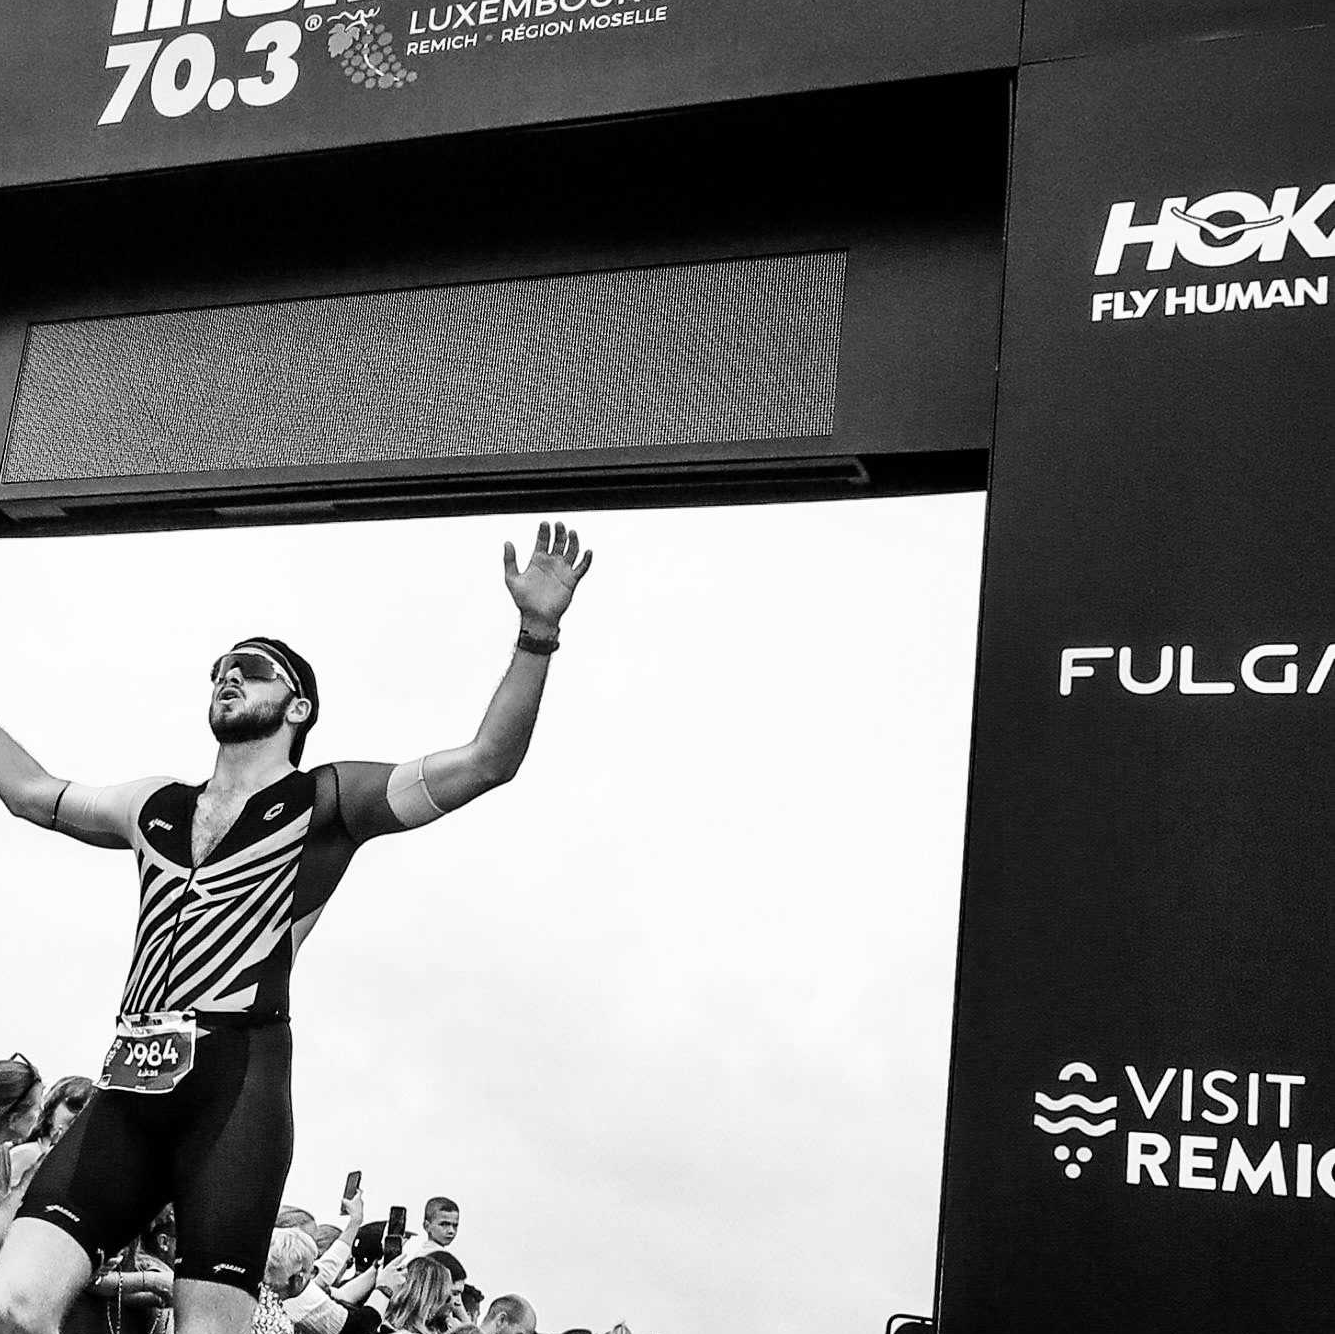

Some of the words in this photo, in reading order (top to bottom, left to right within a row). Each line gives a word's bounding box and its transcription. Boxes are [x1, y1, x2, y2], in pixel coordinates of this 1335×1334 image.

[406, 34, 478, 56] REMICH
[500, 17, 574, 43] RÉGION
[578, 6, 668, 33] MOSELLE
[97, 20, 302, 126] 70.3
[1093, 183, 1335, 276] HOK
[1091, 289, 1159, 322] FLY
[1165, 276, 1329, 316] HUMAN
[1124, 1065, 1306, 1128] VISIT
